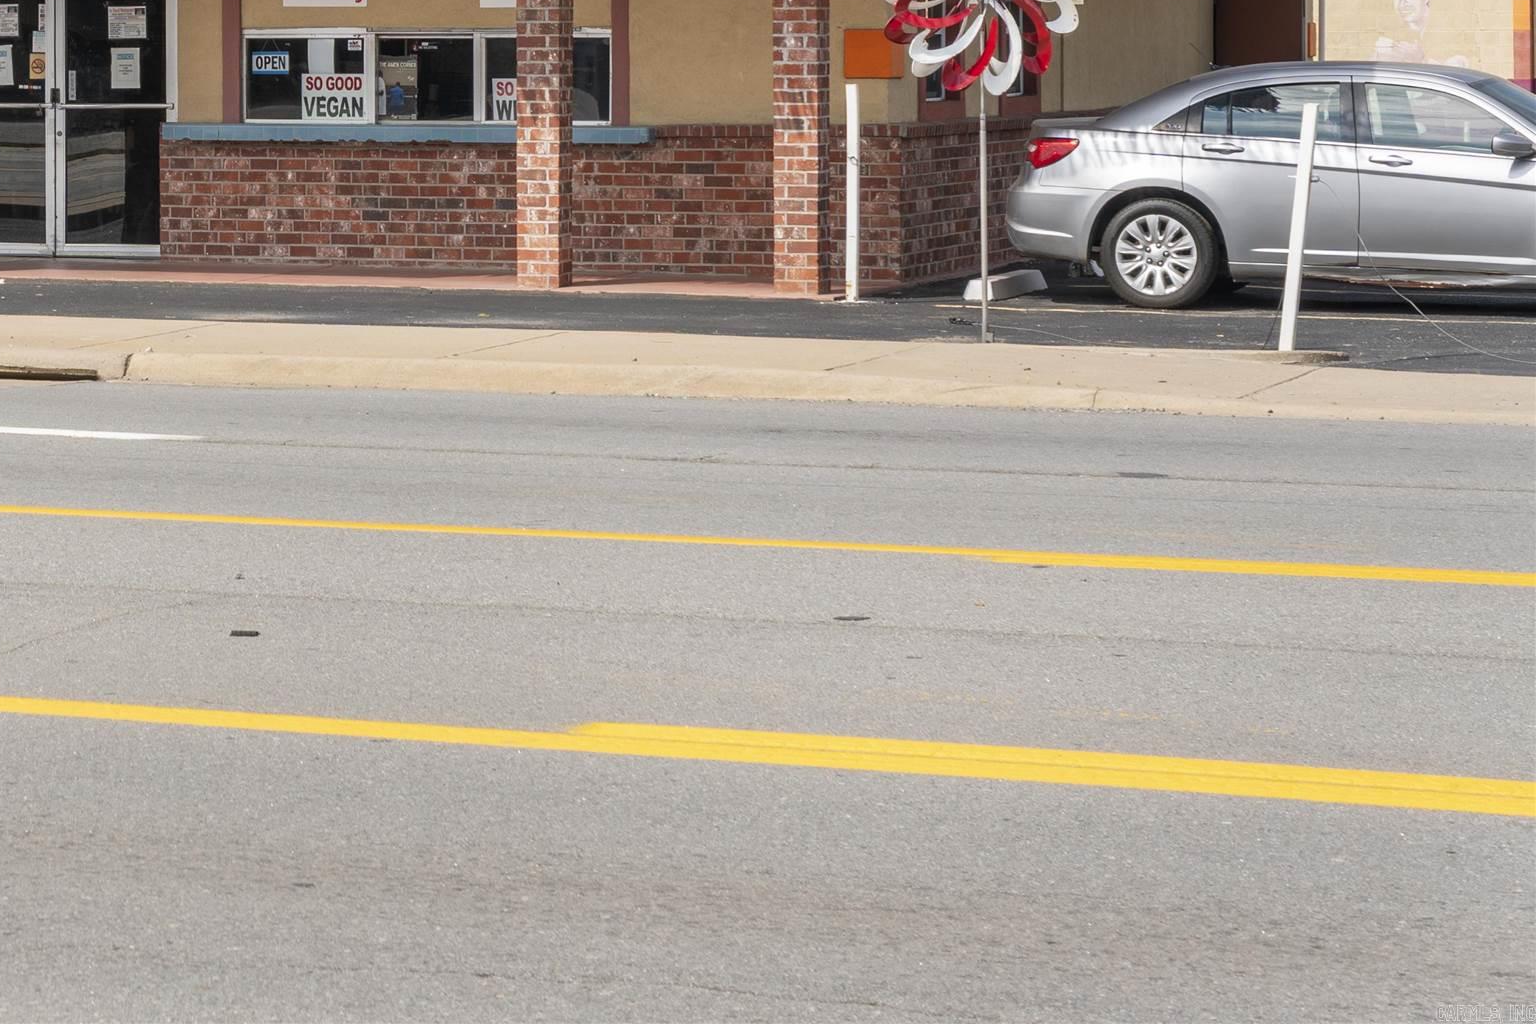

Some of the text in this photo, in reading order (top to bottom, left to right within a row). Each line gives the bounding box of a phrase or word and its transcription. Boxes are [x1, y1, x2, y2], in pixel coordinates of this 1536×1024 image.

[256, 56, 286, 70] OPEN
[306, 76, 362, 91] SO GOOD
[496, 81, 514, 96] SO
[303, 96, 364, 118] VEGAN
